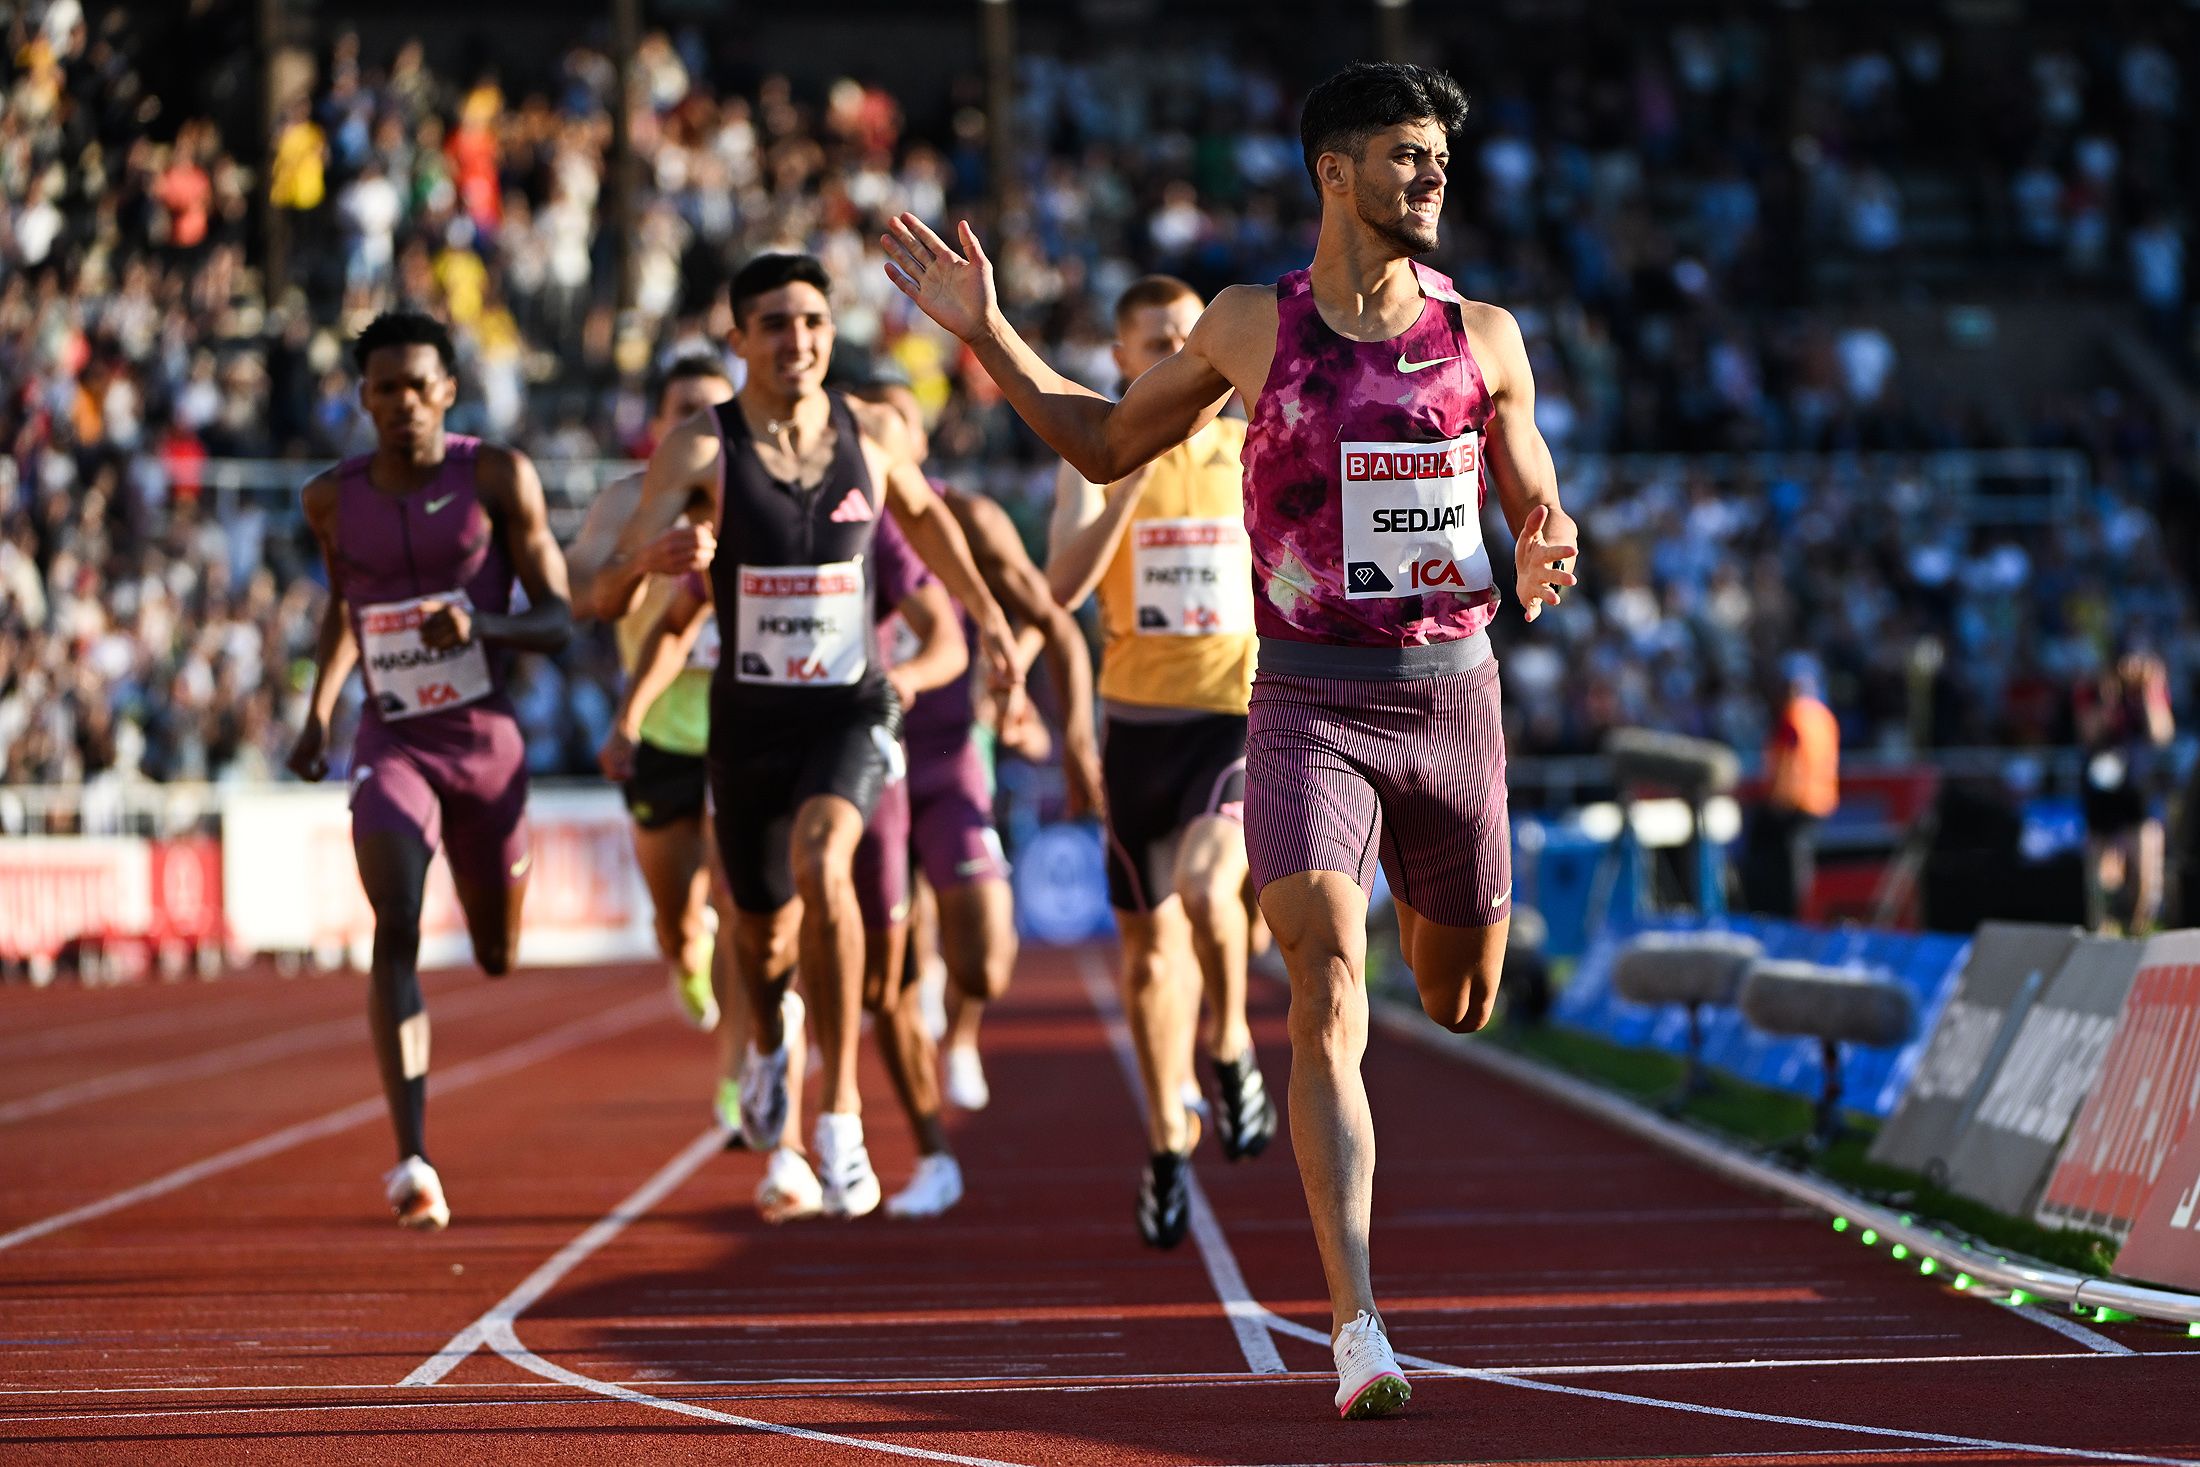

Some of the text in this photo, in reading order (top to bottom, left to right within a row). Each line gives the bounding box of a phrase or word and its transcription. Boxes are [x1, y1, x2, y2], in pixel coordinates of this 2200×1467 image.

[1372, 503, 1465, 533] SEDJATI
[1411, 559, 1466, 590] ICA
[786, 656, 828, 682] ICA
[417, 682, 460, 707] ICA
